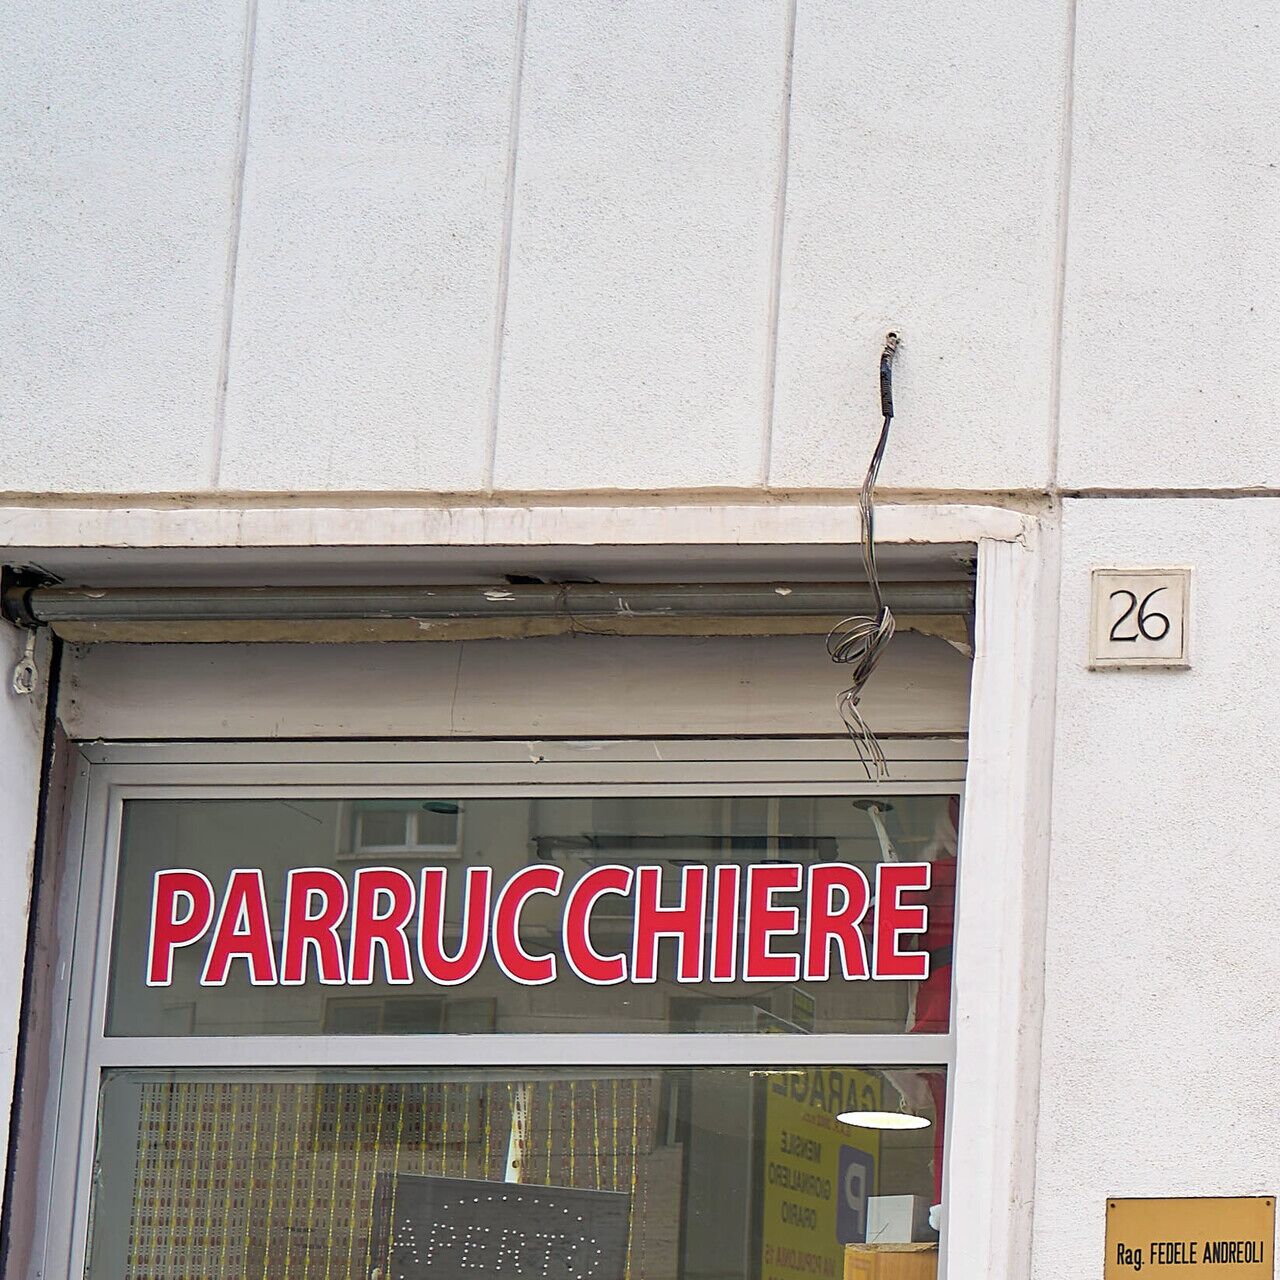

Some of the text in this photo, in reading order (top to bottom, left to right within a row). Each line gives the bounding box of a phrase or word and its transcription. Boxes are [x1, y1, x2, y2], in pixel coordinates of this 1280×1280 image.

[1109, 587, 1170, 642] 26
[146, 862, 931, 987] PARRUCCHIERE
[390, 1220, 602, 1279] APERTO
[1117, 1241, 1264, 1271] Rag. FEDELE ANDREOLI
